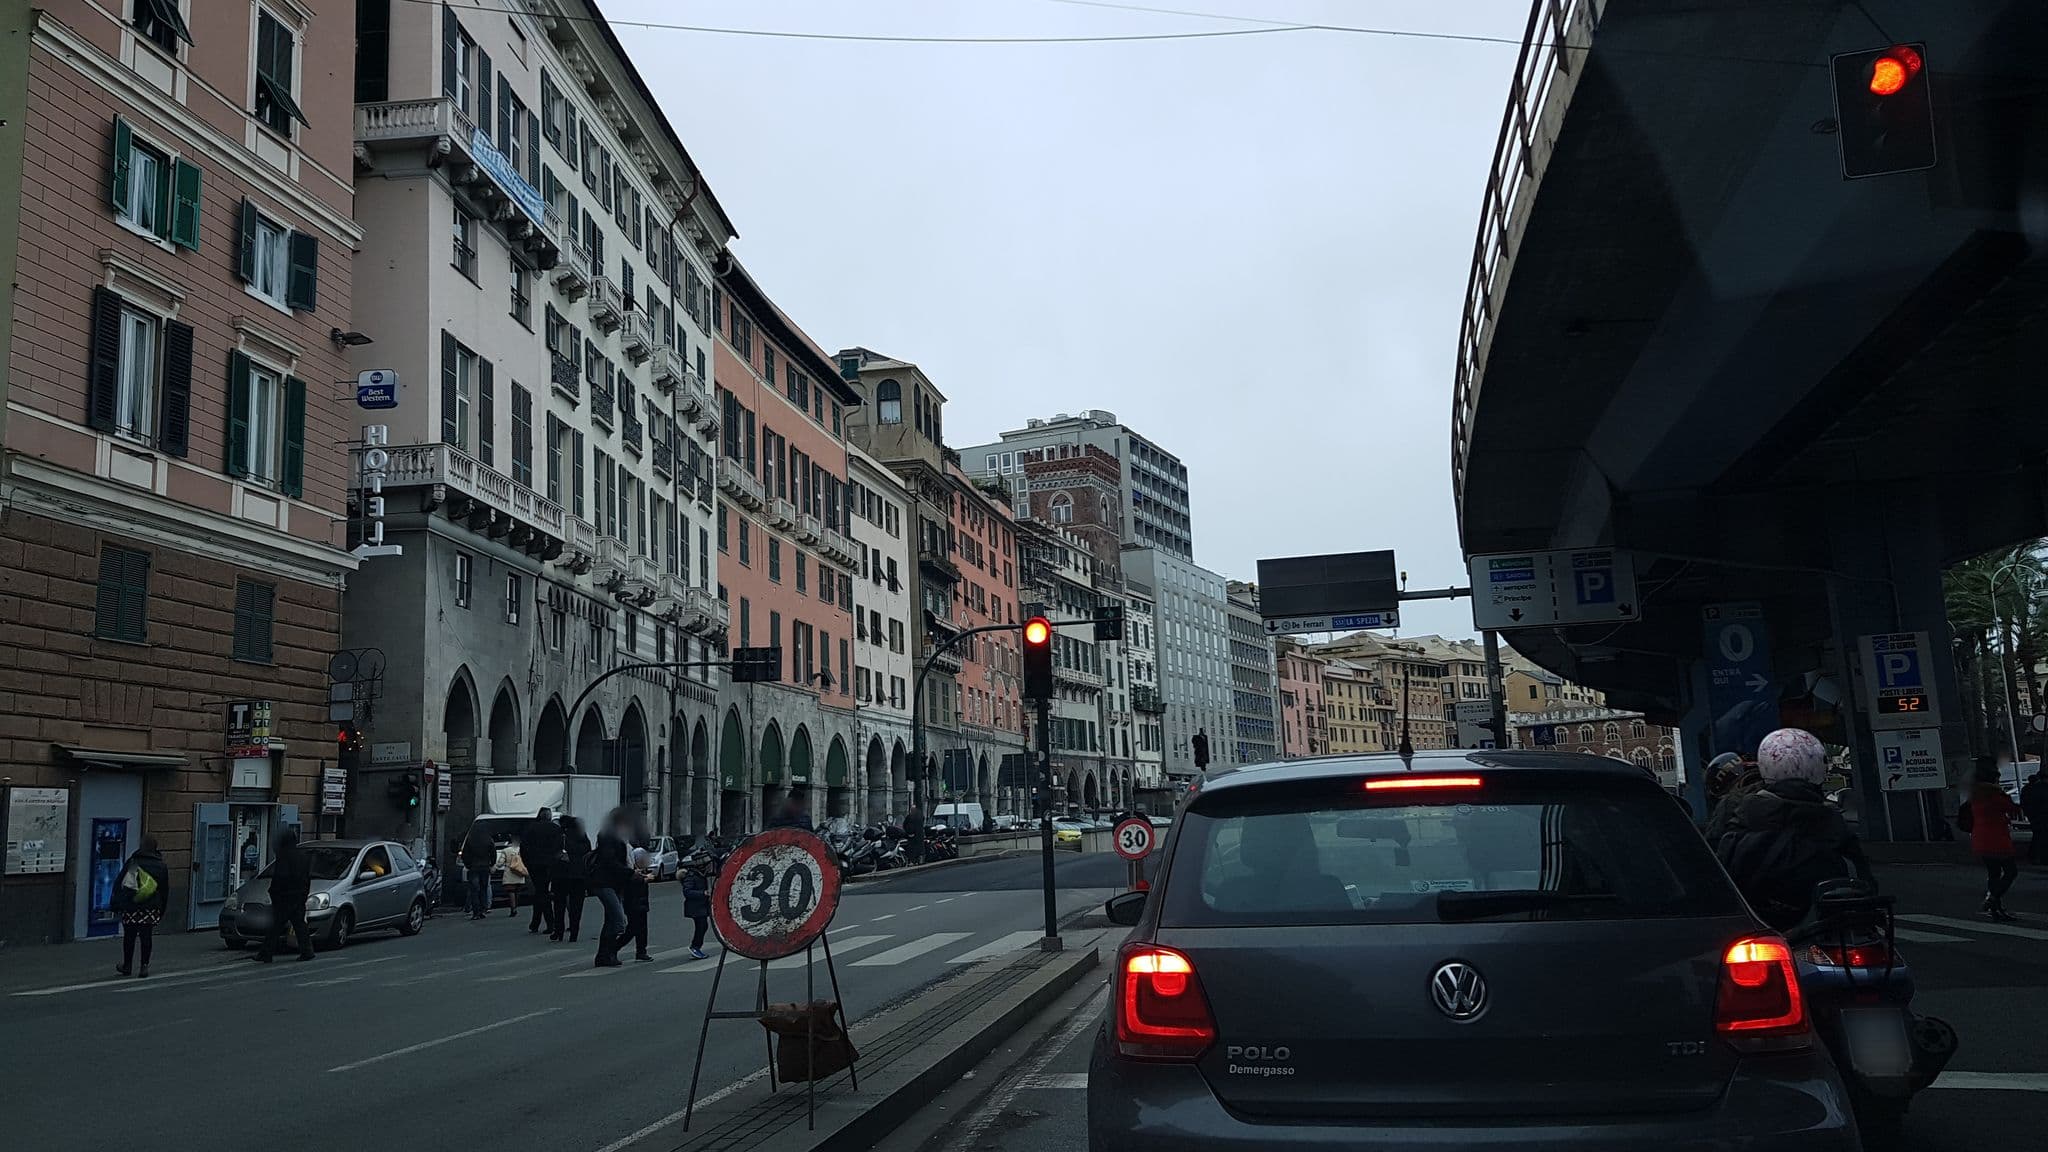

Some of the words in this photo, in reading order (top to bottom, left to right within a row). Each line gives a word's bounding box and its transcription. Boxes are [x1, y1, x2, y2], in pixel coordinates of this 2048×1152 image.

[368, 388, 385, 396] Best
[1503, 583, 1537, 593] aeroporto
[1582, 573, 1606, 602] P
[1503, 595, 1532, 604] Principe
[1292, 620, 1300, 629] De
[1303, 619, 1325, 629] Ferrari
[1346, 619, 1355, 627] LA
[1357, 616, 1379, 626] SPEZIA
[1884, 653, 1911, 686] P
[1880, 688, 1899, 697] POSTI
[1902, 687, 1924, 696] LIBERI
[1898, 697, 1921, 712] 52
[233, 705, 249, 730] T
[1886, 748, 1899, 763] P
[1905, 758, 1937, 767] ACQUARIO
[1123, 830, 1146, 849] 30
[740, 862, 813, 923] 30
[1227, 1046, 1291, 1061] POLO
[1229, 1063, 1296, 1078] Demergasso
